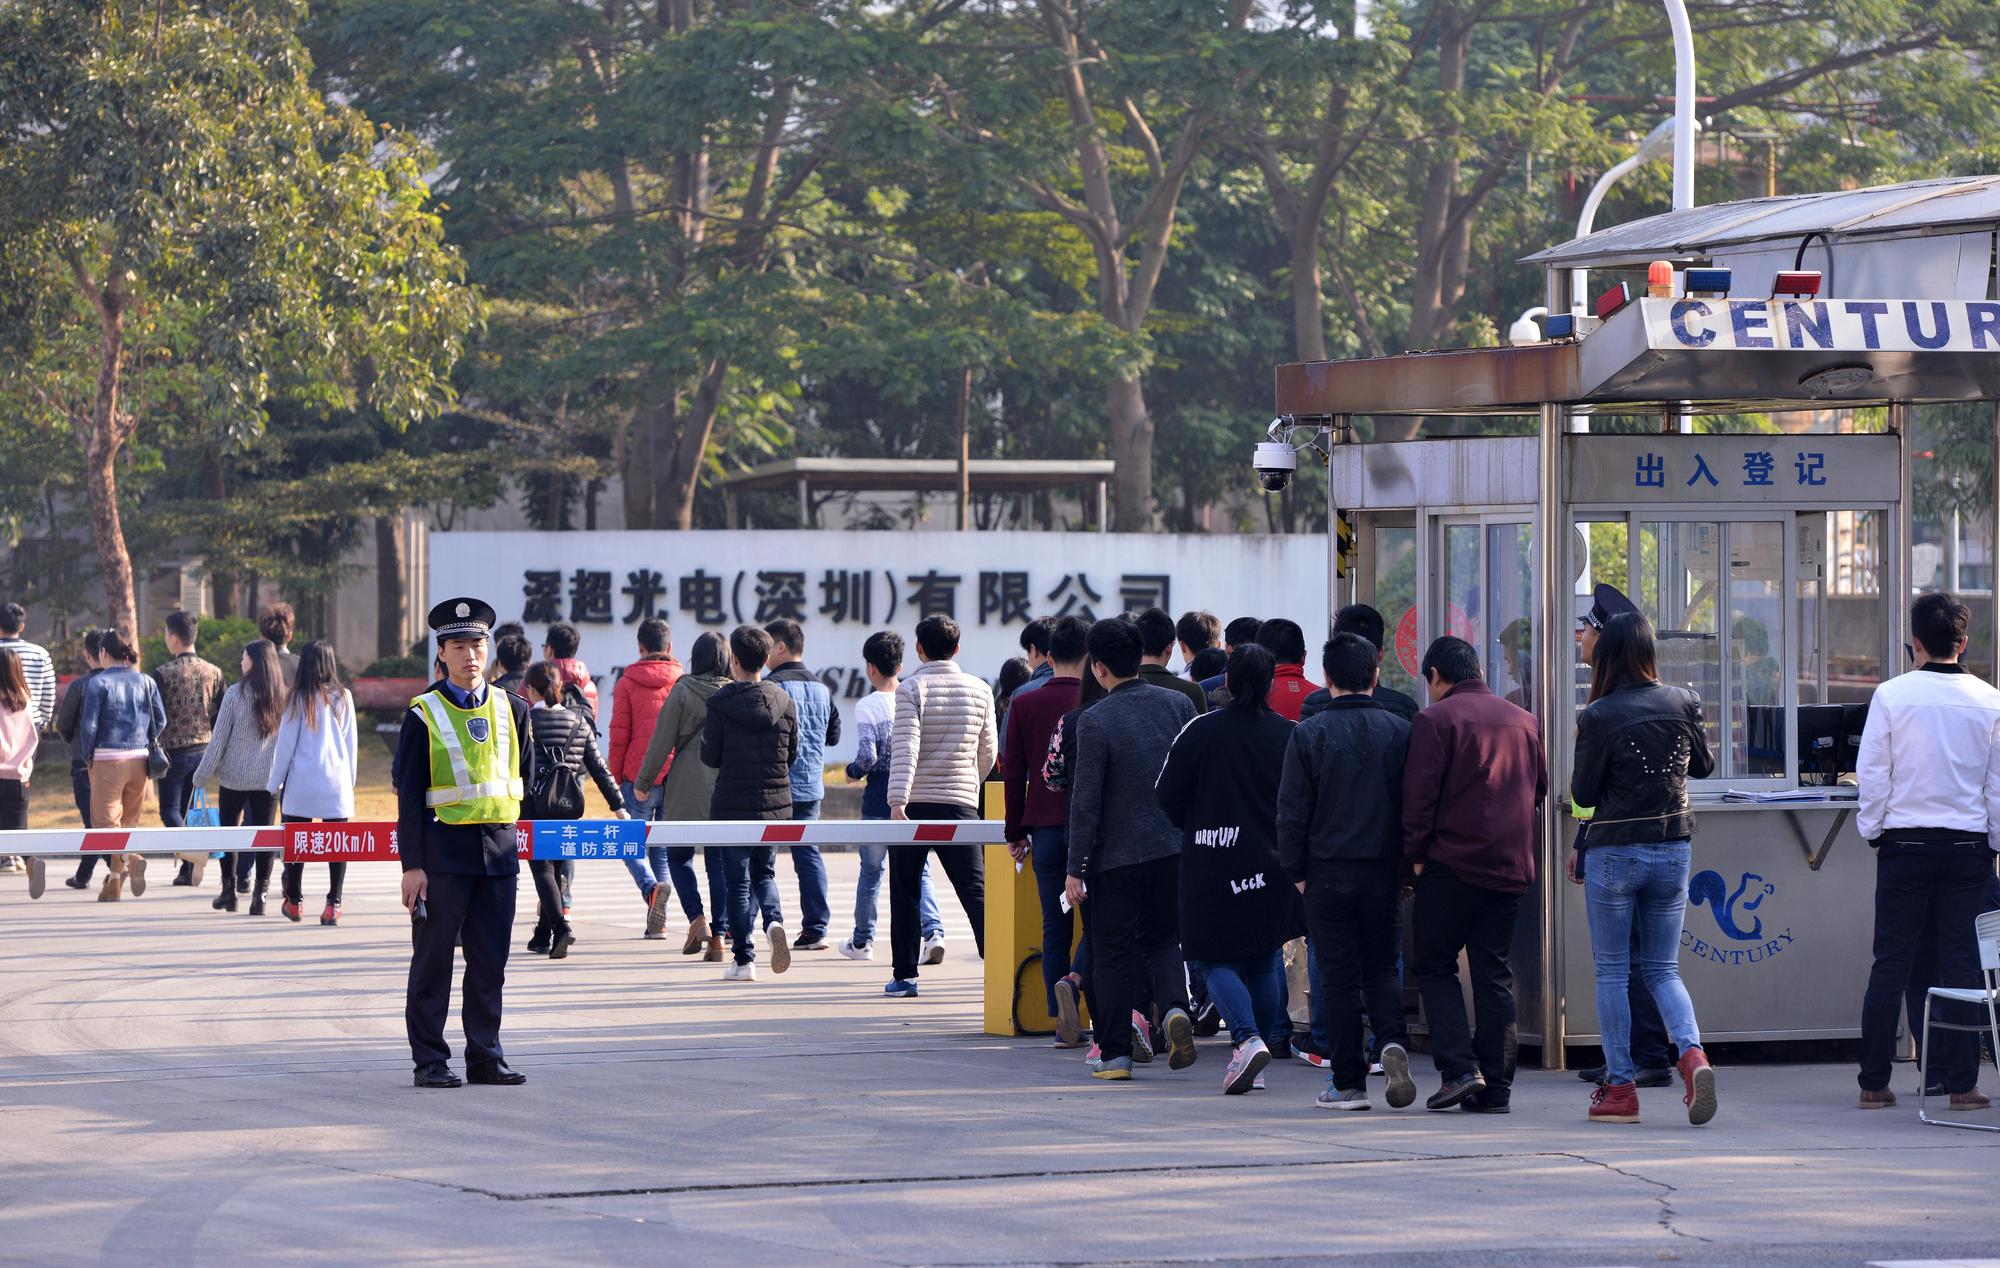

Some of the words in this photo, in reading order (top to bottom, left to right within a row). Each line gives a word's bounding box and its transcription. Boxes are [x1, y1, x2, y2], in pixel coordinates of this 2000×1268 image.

[1670, 301, 2000, 350] CENTUR
[1635, 452, 1826, 488] 出入登记
[294, 831, 375, 855] 限速20km/h
[540, 824, 620, 839] 一车一杆
[560, 842, 638, 856] 谨防落闸
[1680, 927, 1795, 965] CENTURY
